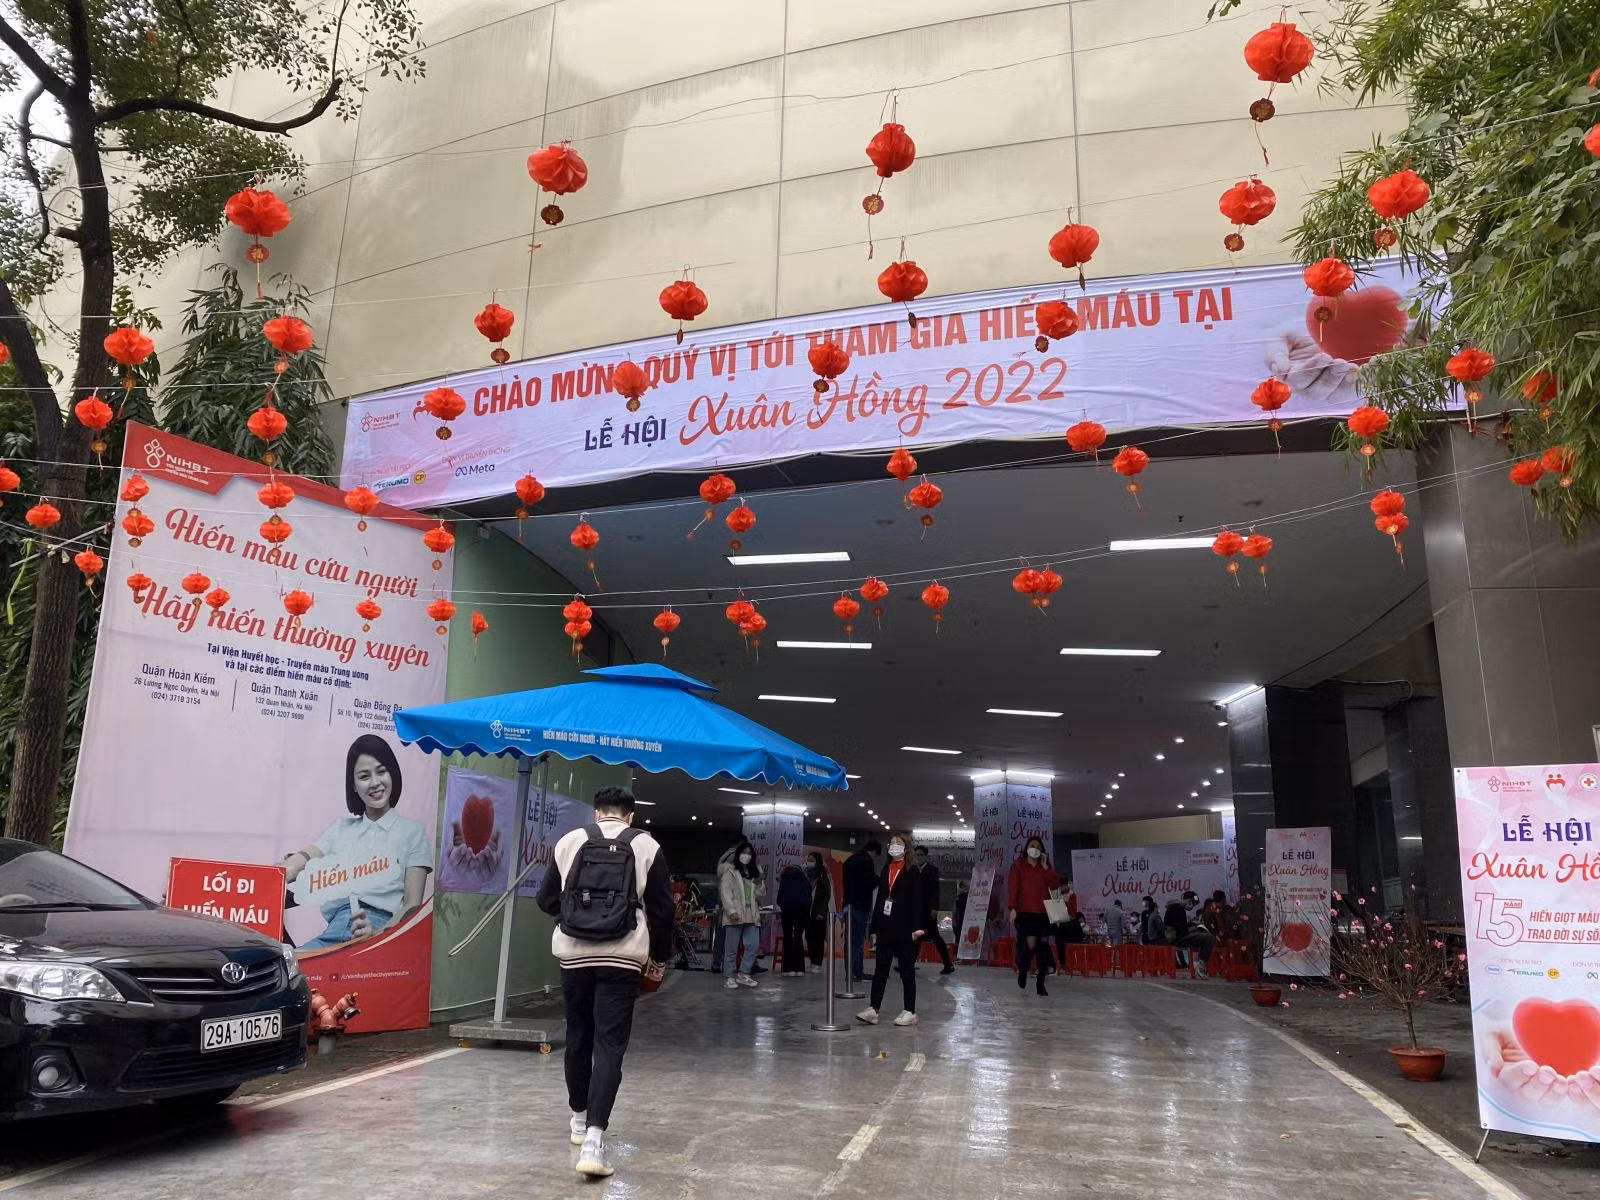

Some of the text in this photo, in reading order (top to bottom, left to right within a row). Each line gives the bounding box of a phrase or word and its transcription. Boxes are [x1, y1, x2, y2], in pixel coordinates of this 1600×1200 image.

[473, 374, 542, 417] CHÀO
[550, 361, 615, 403] MỪN
[644, 344, 700, 390] QUÝ
[709, 344, 737, 382] VỊ
[747, 330, 794, 371] TỚI
[910, 313, 968, 350] GIA
[979, 293, 1038, 342] HIẾ
[1076, 288, 1161, 332] MÁU
[1172, 287, 1233, 330] TẠI
[679, 356, 1068, 446] Xuân Hồng 2022
[584, 415, 667, 451] LỄ HỘI
[166, 454, 211, 474] NIHBT
[469, 463, 495, 475] Meta
[165, 508, 419, 599] Hiến máu cứu người
[139, 582, 201, 632] Hãy
[273, 615, 357, 664] thường
[363, 640, 430, 671] xuyên
[207, 642, 220, 654] Tại
[222, 645, 239, 657] Viện
[241, 648, 264, 662] Huyết
[265, 654, 279, 666] học
[331, 665, 350, 678] Trung
[237, 661, 248, 672] tại
[142, 663, 216, 685] Quận Hoàn Kiếm
[151, 692, 167, 701] (024)
[251, 682, 318, 702] Quận Thanh Xuân
[255, 696, 265, 704] 132
[354, 698, 372, 710] Quận
[556, 731, 568, 742] MÁU
[1502, 815, 1592, 846] LỄ HỘI
[309, 856, 390, 894] Hiến máu
[1116, 856, 1150, 873] LỄ HỘI
[1467, 852, 1548, 881] Xuân
[203, 870, 255, 894] LỐI ĐI
[1102, 873, 1144, 897] Xuân
[229, 903, 269, 925] MÁU
[1474, 892, 1524, 947] 15
[1529, 909, 1599, 926] HIẾN GIỌT MÁU
[1527, 928, 1552, 940] TRAO
[1554, 928, 1570, 941] ĐỜI
[205, 1015, 280, 1048] 29A-105.76
